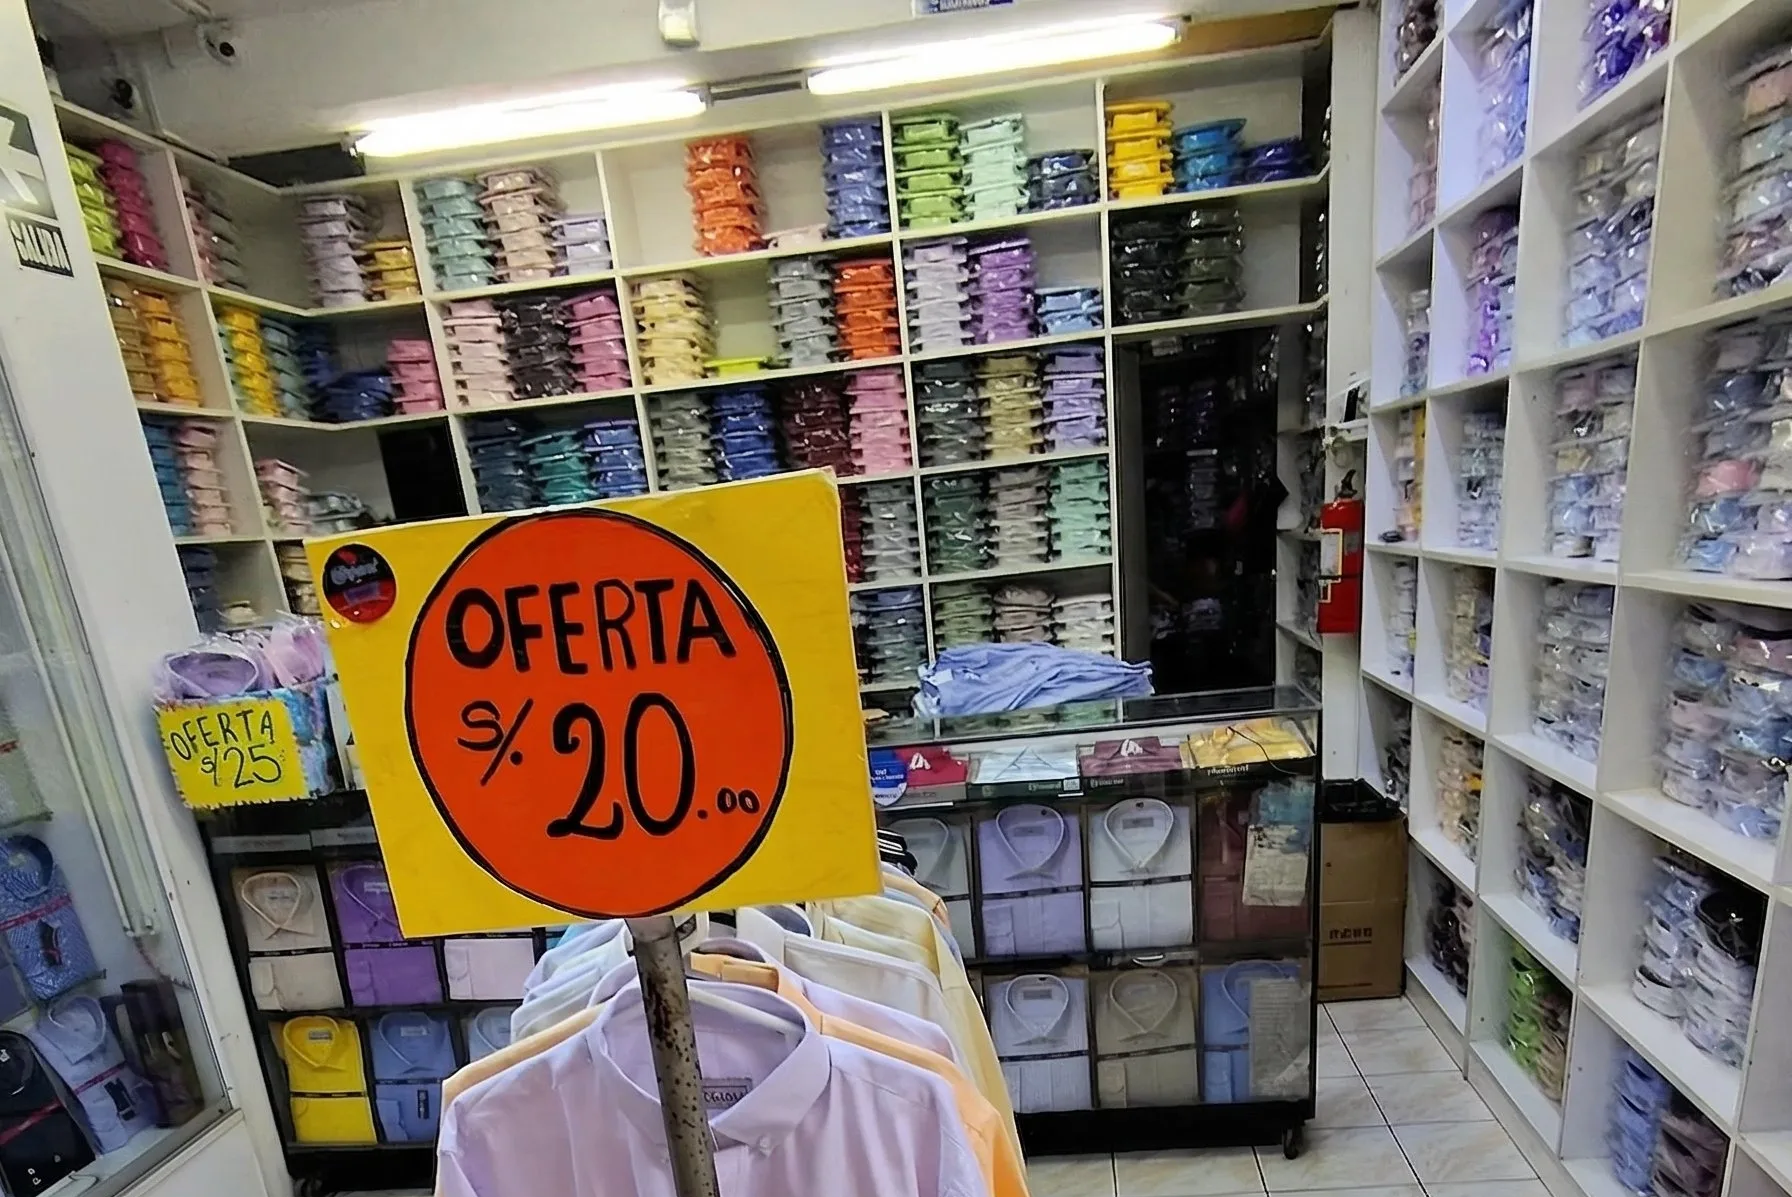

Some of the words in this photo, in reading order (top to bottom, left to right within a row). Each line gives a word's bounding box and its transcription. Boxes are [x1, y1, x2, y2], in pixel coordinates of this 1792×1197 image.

[10, 219, 71, 271] SALIDA
[445, 578, 737, 675] OFERTA
[170, 709, 275, 761] OFERTA
[457, 698, 534, 786] S/.
